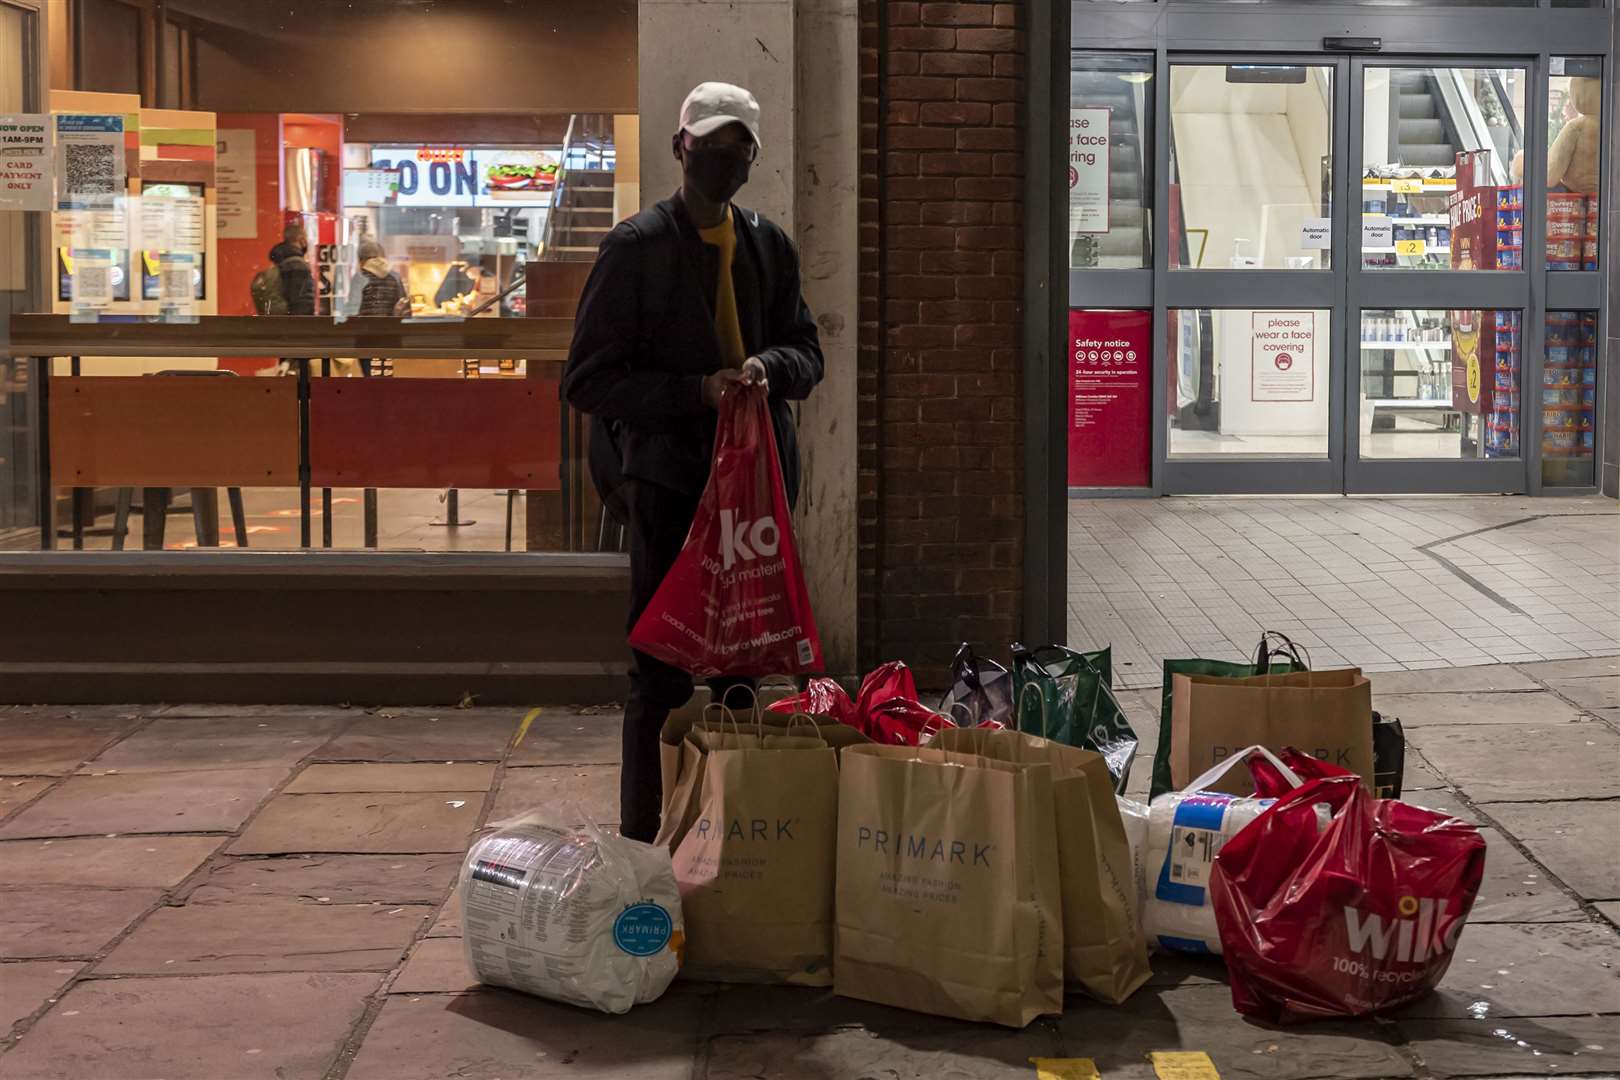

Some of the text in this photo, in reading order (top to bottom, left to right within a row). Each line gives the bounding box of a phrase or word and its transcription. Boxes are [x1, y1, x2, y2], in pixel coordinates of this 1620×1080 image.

[1077, 134, 1107, 145] face
[1268, 318, 1300, 328] please
[1255, 330, 1312, 339] wear a face
[1075, 338, 1130, 349] Safety notice
[1263, 342, 1304, 353] covering
[750, 625, 803, 648] wilko.com
[858, 826, 992, 869] PRIMARK
[1333, 956, 1369, 980] 100%
